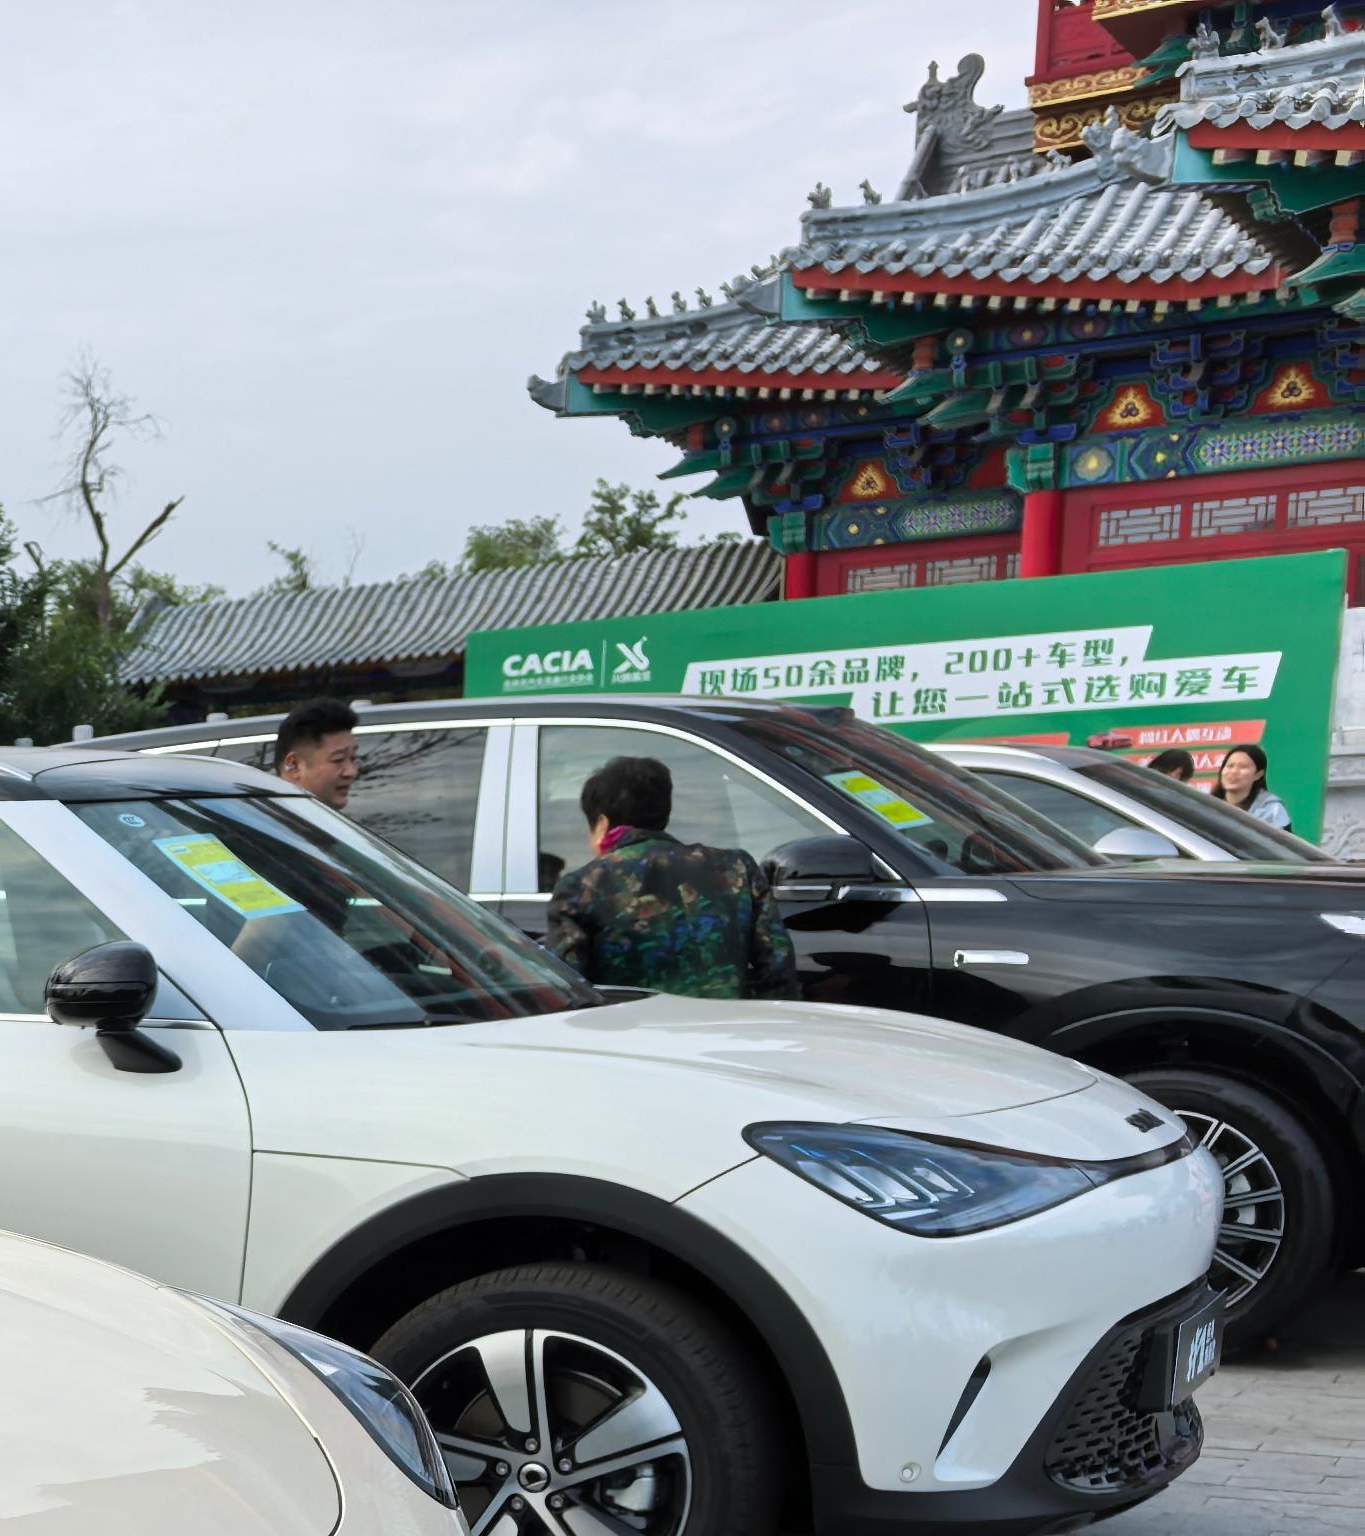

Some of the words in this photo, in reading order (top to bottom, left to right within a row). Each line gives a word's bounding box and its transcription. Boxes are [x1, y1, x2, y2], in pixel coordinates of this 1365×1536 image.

[502, 649, 594, 677] CACIA
[872, 666, 1260, 717] 让您一站式选购爱车
